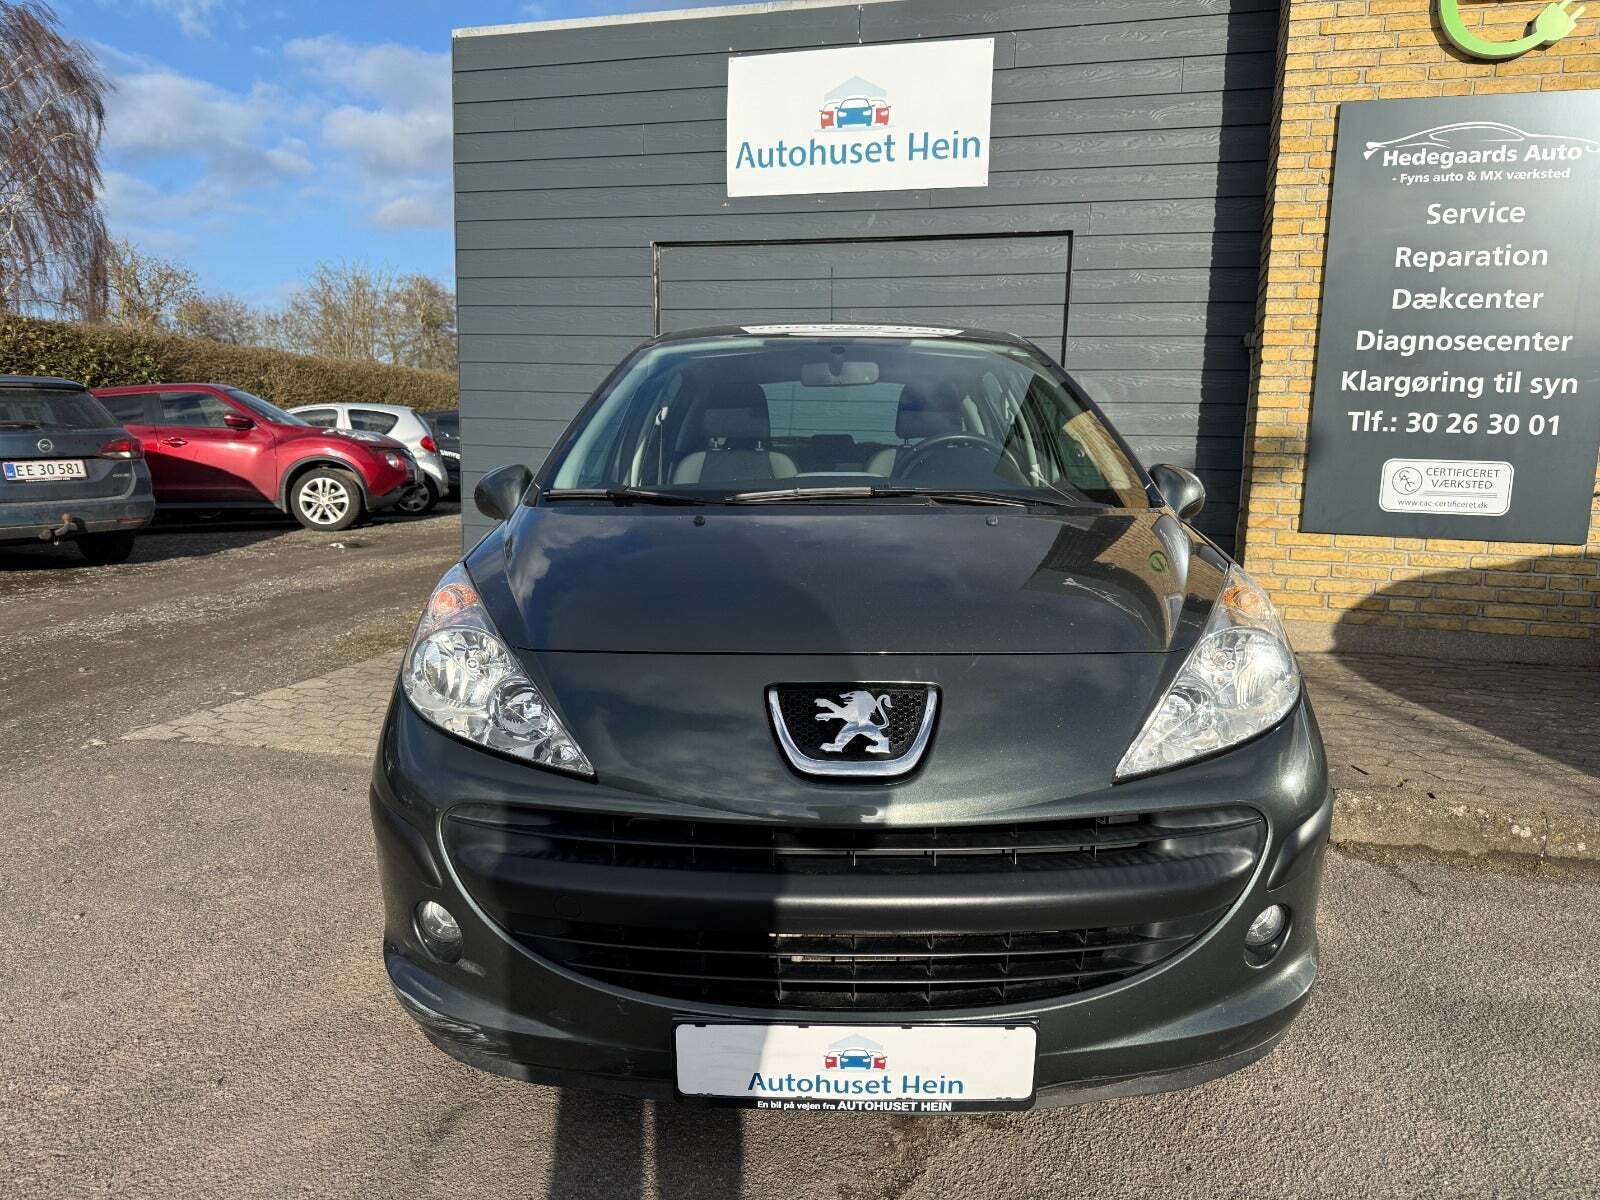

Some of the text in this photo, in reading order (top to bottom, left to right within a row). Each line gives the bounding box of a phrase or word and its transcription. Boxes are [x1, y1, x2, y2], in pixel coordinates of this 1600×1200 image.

[735, 130, 981, 169] Autohuset Hein
[1382, 144, 1583, 169] Hedegaards Auto
[1400, 173, 1430, 186] Fyns
[1432, 173, 1464, 183] auto
[1466, 172, 1477, 182] &
[1480, 170, 1504, 181] MX
[1506, 167, 1571, 180] værksted
[1426, 201, 1526, 225] Service
[1394, 244, 1549, 272] Reparation
[1391, 287, 1544, 310] Dækcenter
[1355, 329, 1573, 357] Diagnosecenter
[1341, 370, 1578, 400] Klargøring til syn
[1348, 410, 1560, 436] Tlf.: 30 26 30 01
[15, 465, 35, 477] EE
[39, 464, 55, 475] 30
[58, 463, 82, 475] 581
[1426, 467, 1501, 478] CERTIFICERET
[1431, 479, 1493, 490] VÆRKSTED
[1397, 500, 1489, 509] www.cac-certificeret.dk
[747, 1072, 964, 1094] Autohuset Hein
[757, 1101, 952, 1112] En bil på vejen fra AUTOHUSET HEIN
